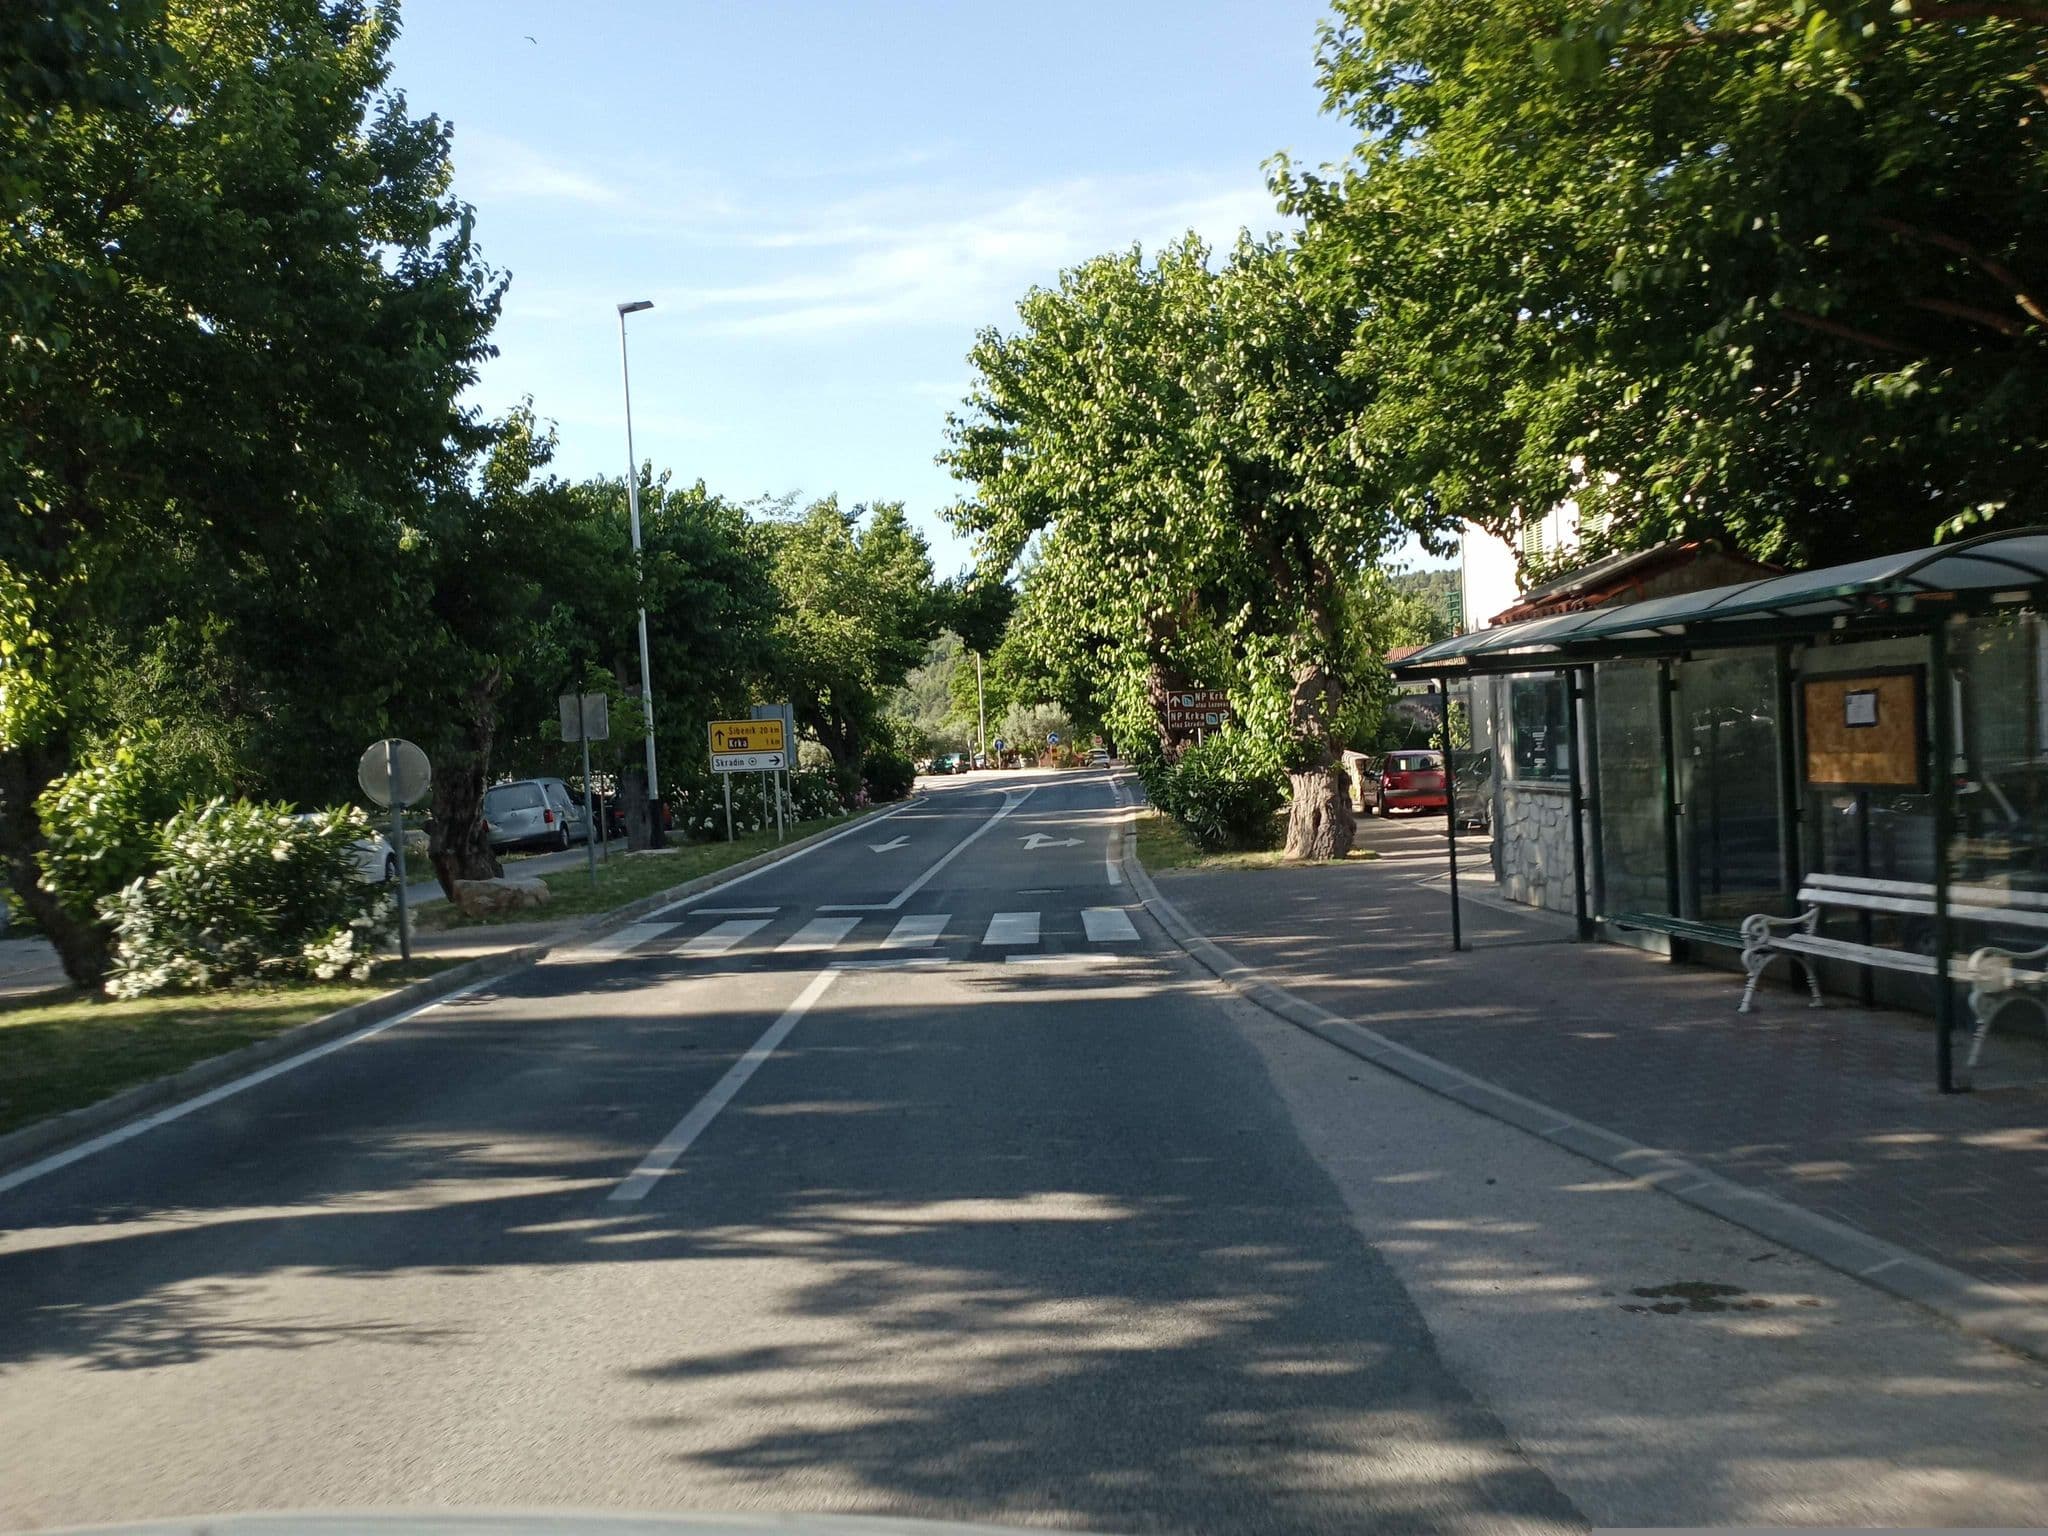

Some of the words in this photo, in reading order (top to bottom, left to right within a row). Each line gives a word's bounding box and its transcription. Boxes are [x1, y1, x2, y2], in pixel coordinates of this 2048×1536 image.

[1195, 692, 1207, 701] NP
[1170, 711, 1182, 721] NP
[1185, 711, 1205, 721] Krka
[760, 726, 768, 734] 20
[728, 738, 747, 748] Krka
[715, 758, 745, 767] Skradin
